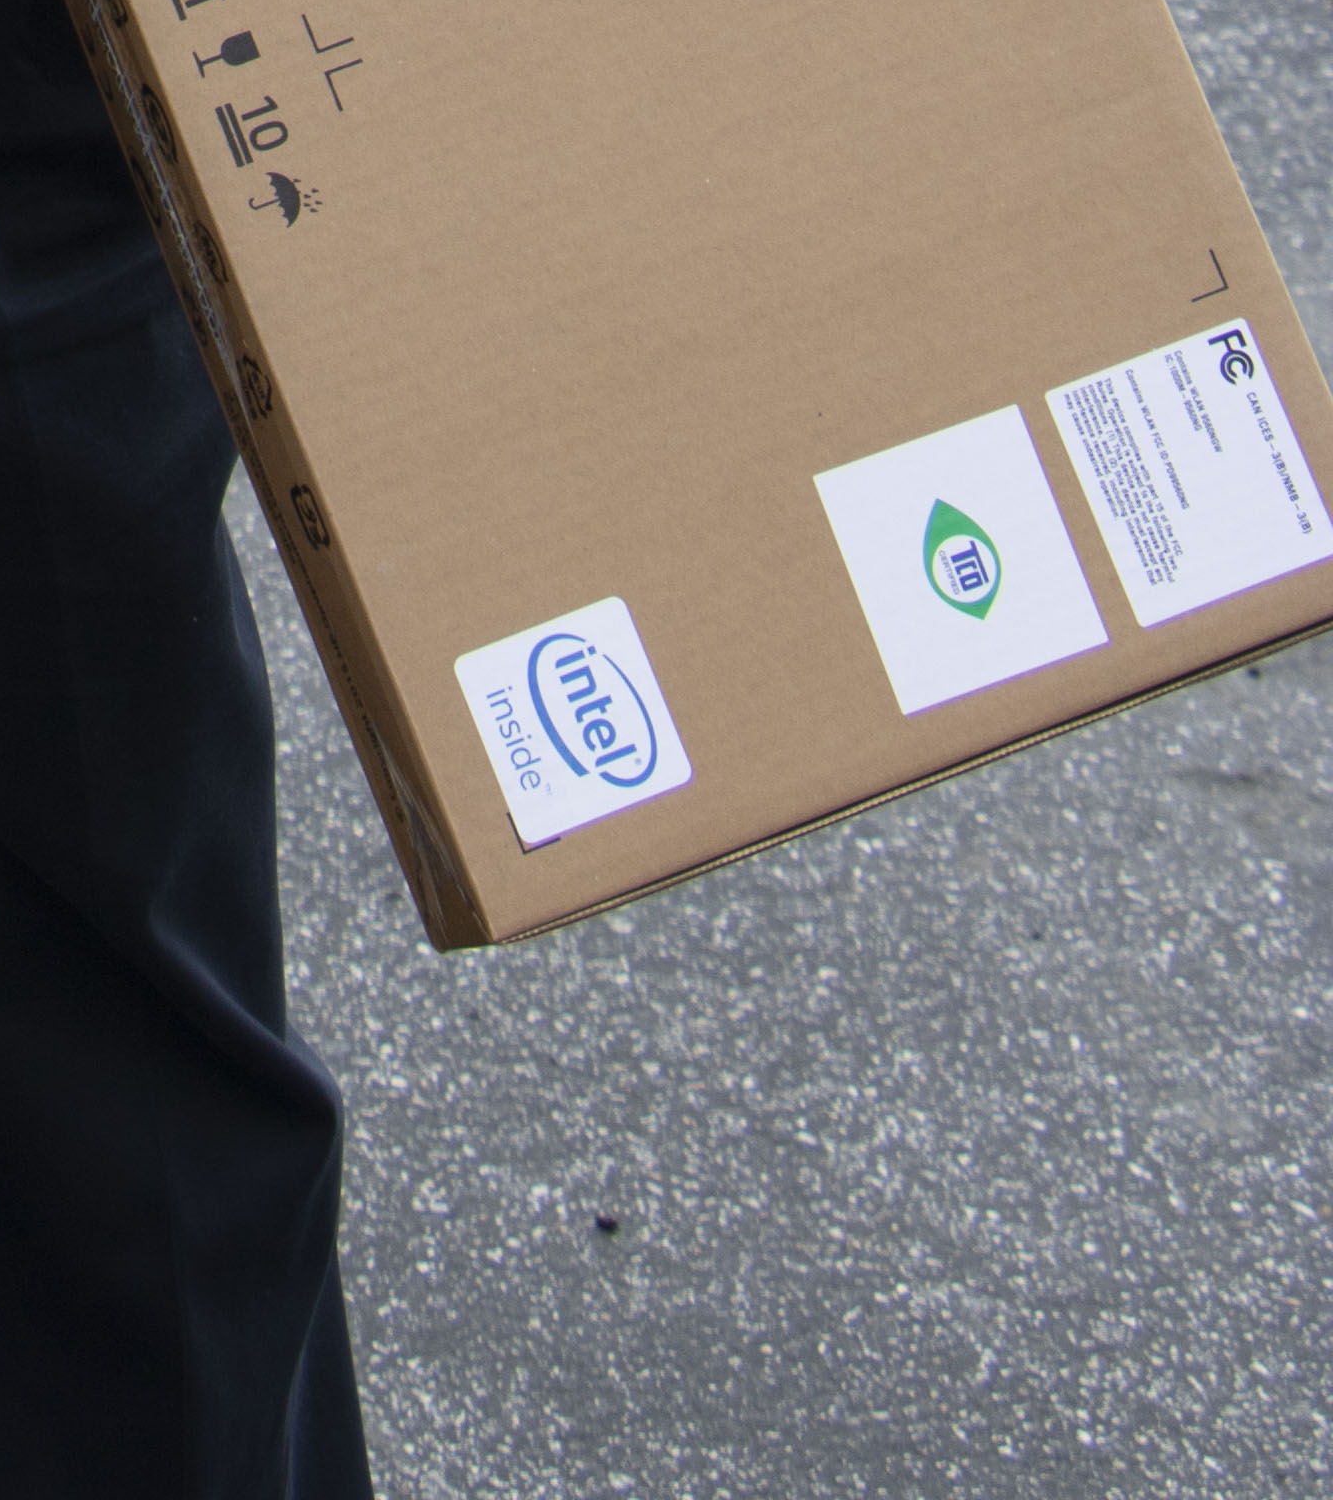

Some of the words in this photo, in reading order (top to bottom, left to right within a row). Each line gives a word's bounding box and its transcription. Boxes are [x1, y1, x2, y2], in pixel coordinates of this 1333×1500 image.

[241, 95, 289, 152] 10
[1246, 392, 1262, 414] CAN
[554, 645, 637, 768] intel
